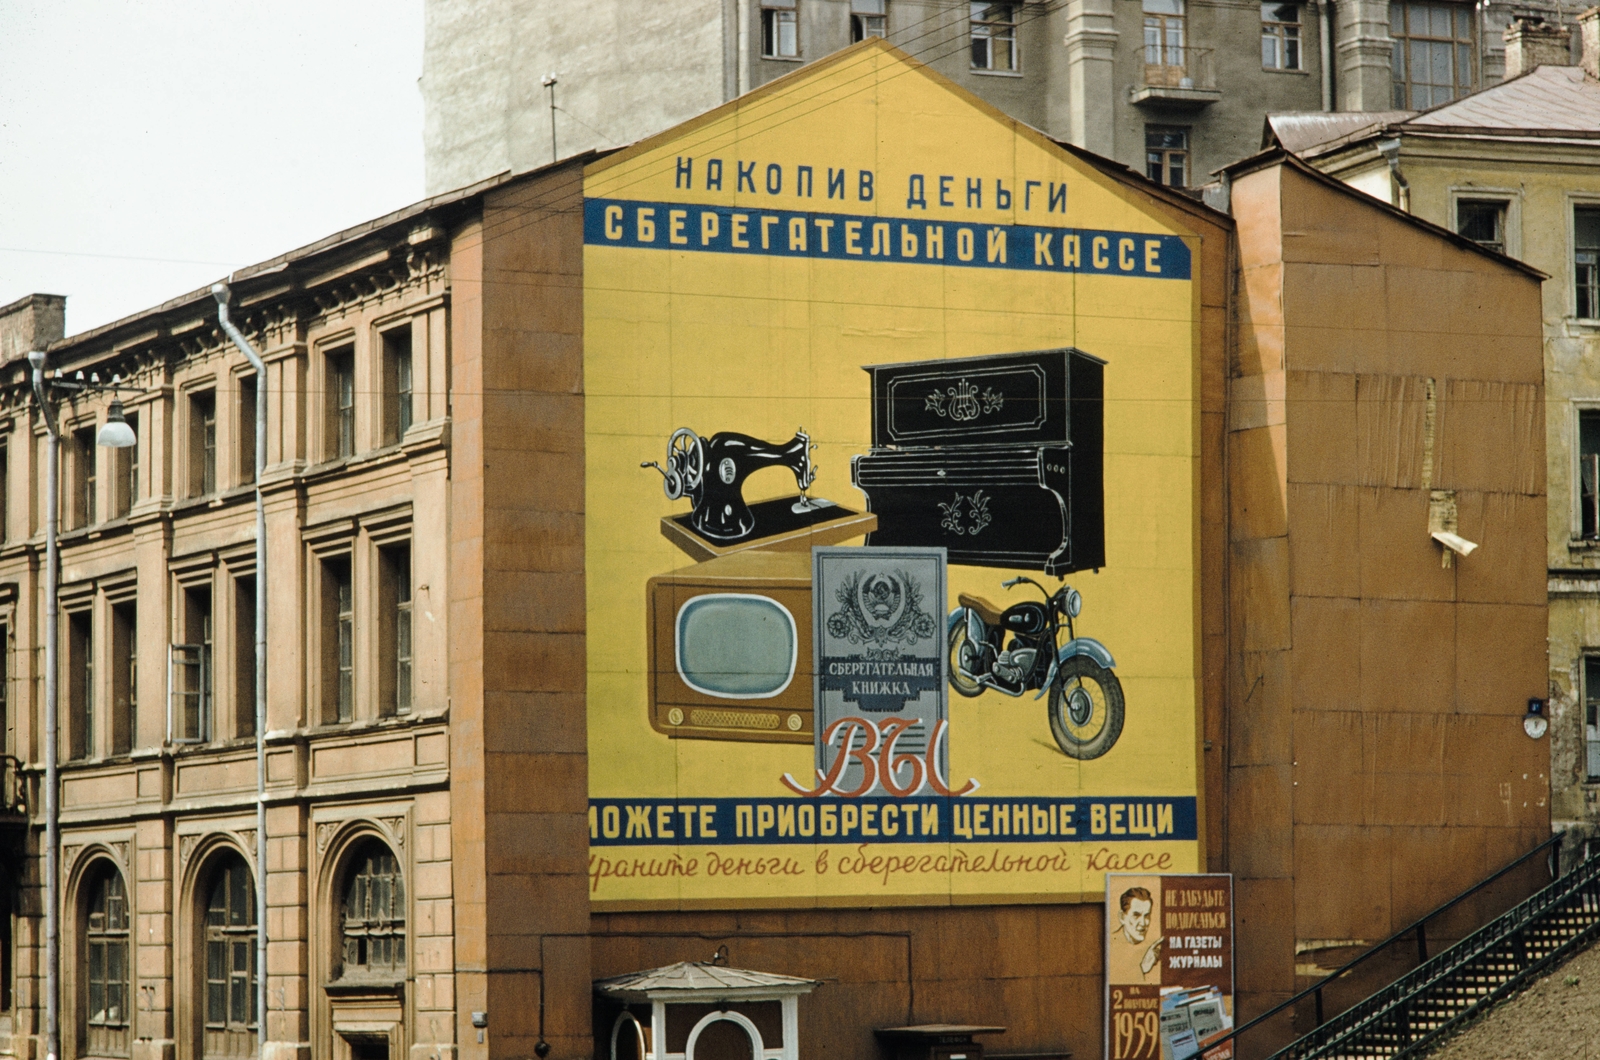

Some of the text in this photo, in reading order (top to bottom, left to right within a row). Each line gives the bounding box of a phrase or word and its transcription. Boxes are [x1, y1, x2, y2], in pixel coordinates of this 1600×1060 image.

[675, 156, 1067, 213] НАКОПИВ ДЕНЬГИ
[604, 205, 1161, 273] СБЕРЕГАТЕЛЬНОЙ КАССЕ
[829, 661, 934, 696] СБЕРЕГАТЕЛЬНАЯ КНИЖКА
[780, 716, 981, 798] ВЫ
[736, 804, 939, 837] ПРИОБРЕСТИ
[953, 804, 1077, 839] ЦЕННЫЕ
[1091, 803, 1173, 837] ВЕЩИ
[706, 851, 806, 876] деньги
[815, 849, 829, 875] в
[838, 842, 1071, 886] сберегательной
[1165, 889, 1225, 908] НЕ ЗАБУДЬТЕ
[1165, 912, 1226, 930] ПОДПИСАТЬСЯ
[1169, 935, 1223, 949] НА ГАЗЕТЫ
[1169, 955, 1223, 969] ЖУРНАЛЫ
[1113, 989, 1123, 1010] 2
[1113, 1011, 1159, 1060] 1959
